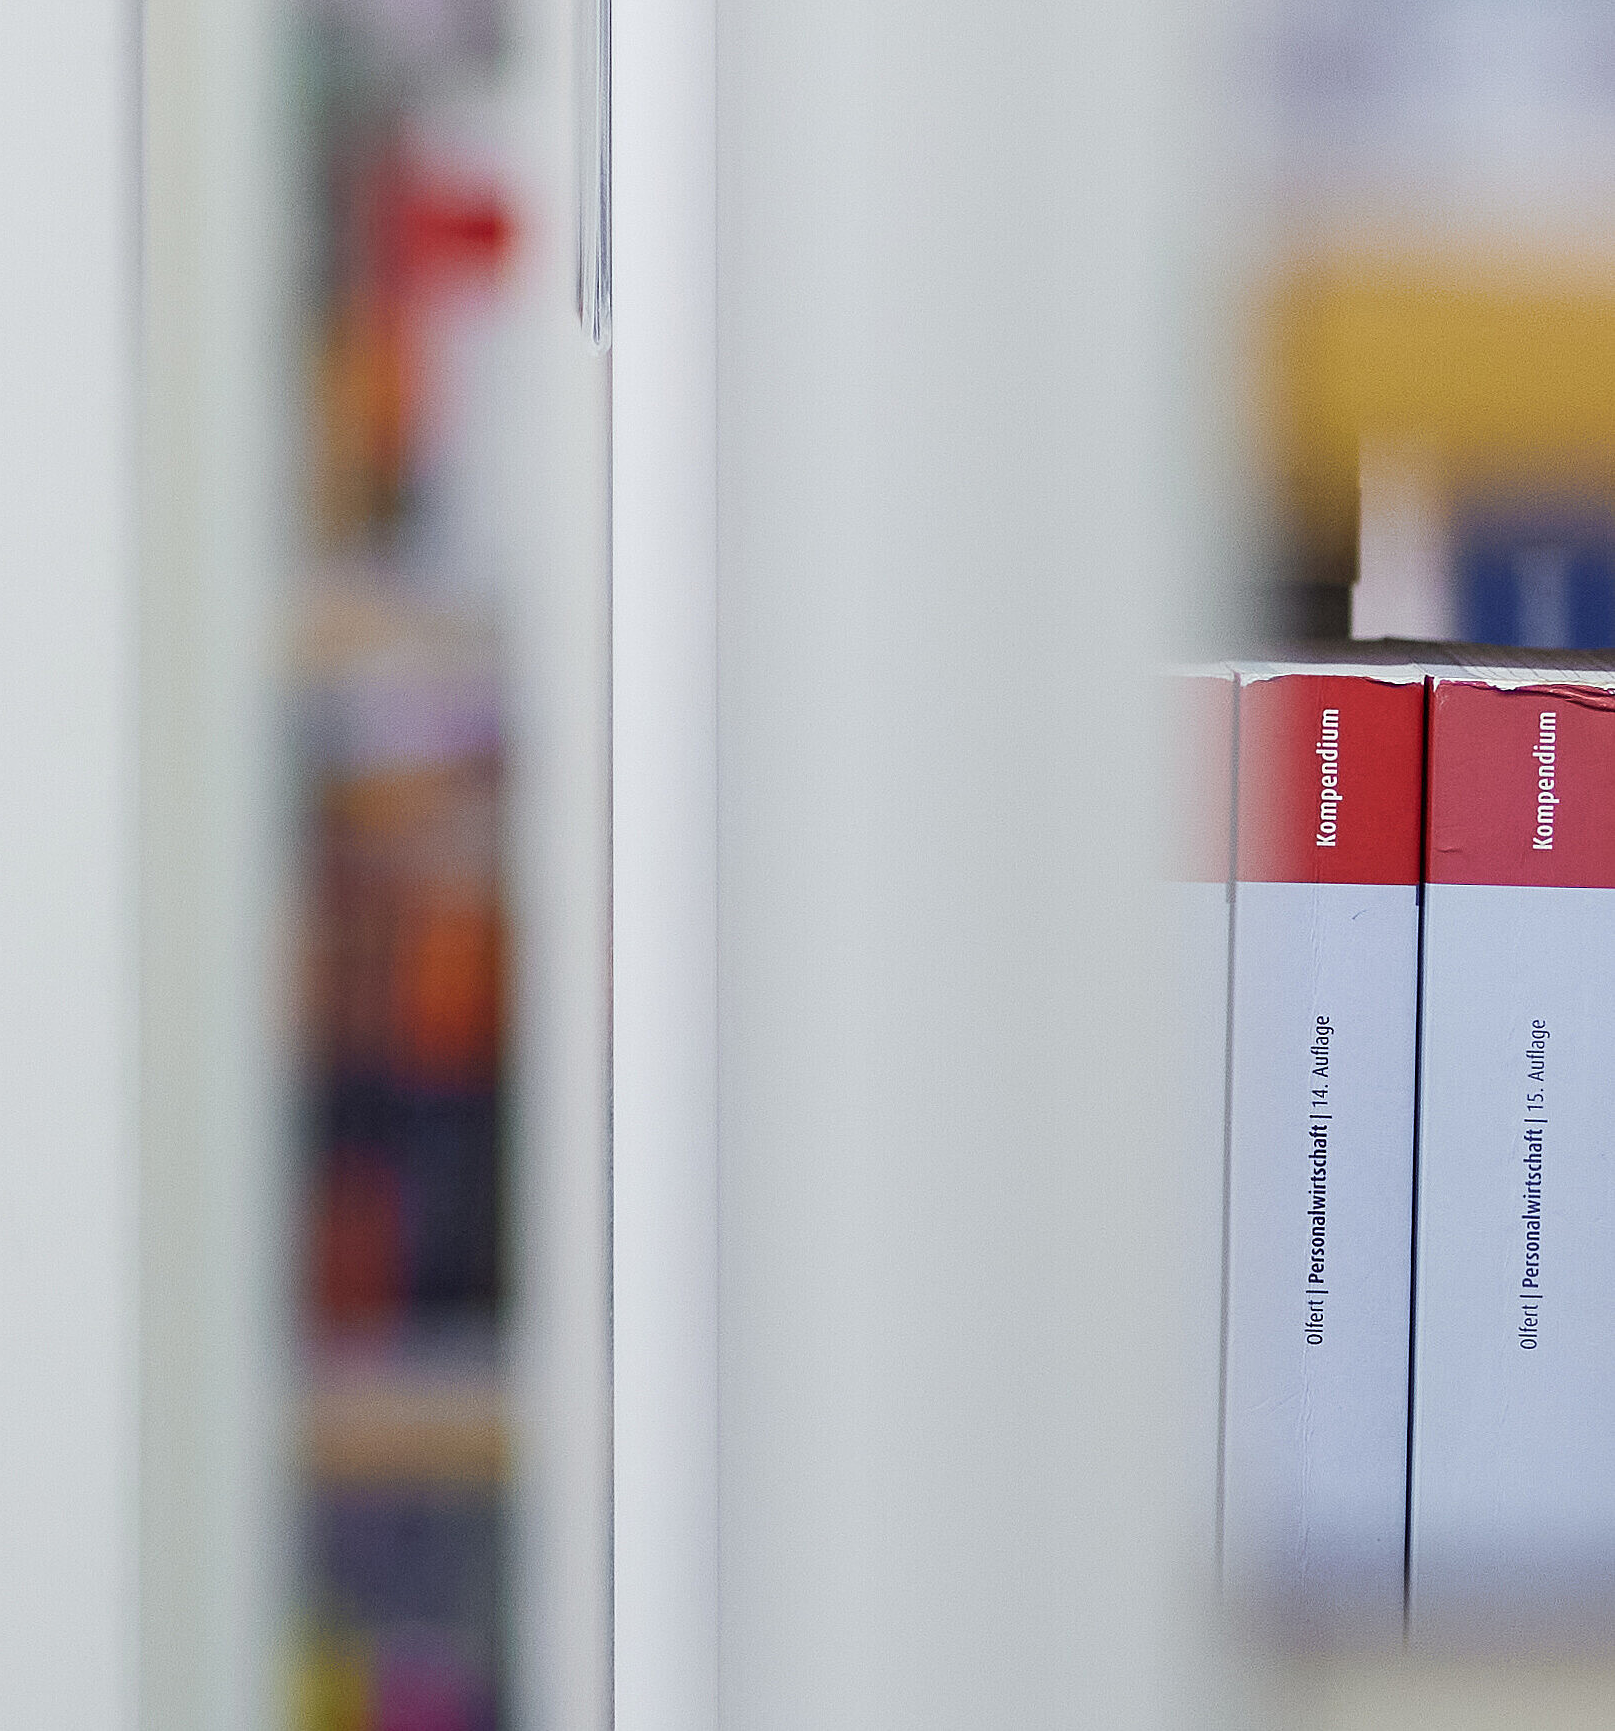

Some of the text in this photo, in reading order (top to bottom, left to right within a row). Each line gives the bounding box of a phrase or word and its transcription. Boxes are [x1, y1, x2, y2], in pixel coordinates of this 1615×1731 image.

[1315, 708, 1343, 847] Kompendium
[1532, 711, 1560, 851] Kompendium
[1310, 1015, 1335, 1078] Auflage
[1525, 1019, 1551, 1082] Auflage
[1311, 1084, 1329, 1108] 14.
[1526, 1088, 1544, 1112] 15.
[1307, 1123, 1328, 1284] Personalwirtschaft
[1522, 1128, 1543, 1289] Personalwirtschaft
[1304, 1299, 1324, 1346] Olfert
[1517, 1303, 1538, 1351] Olfert
